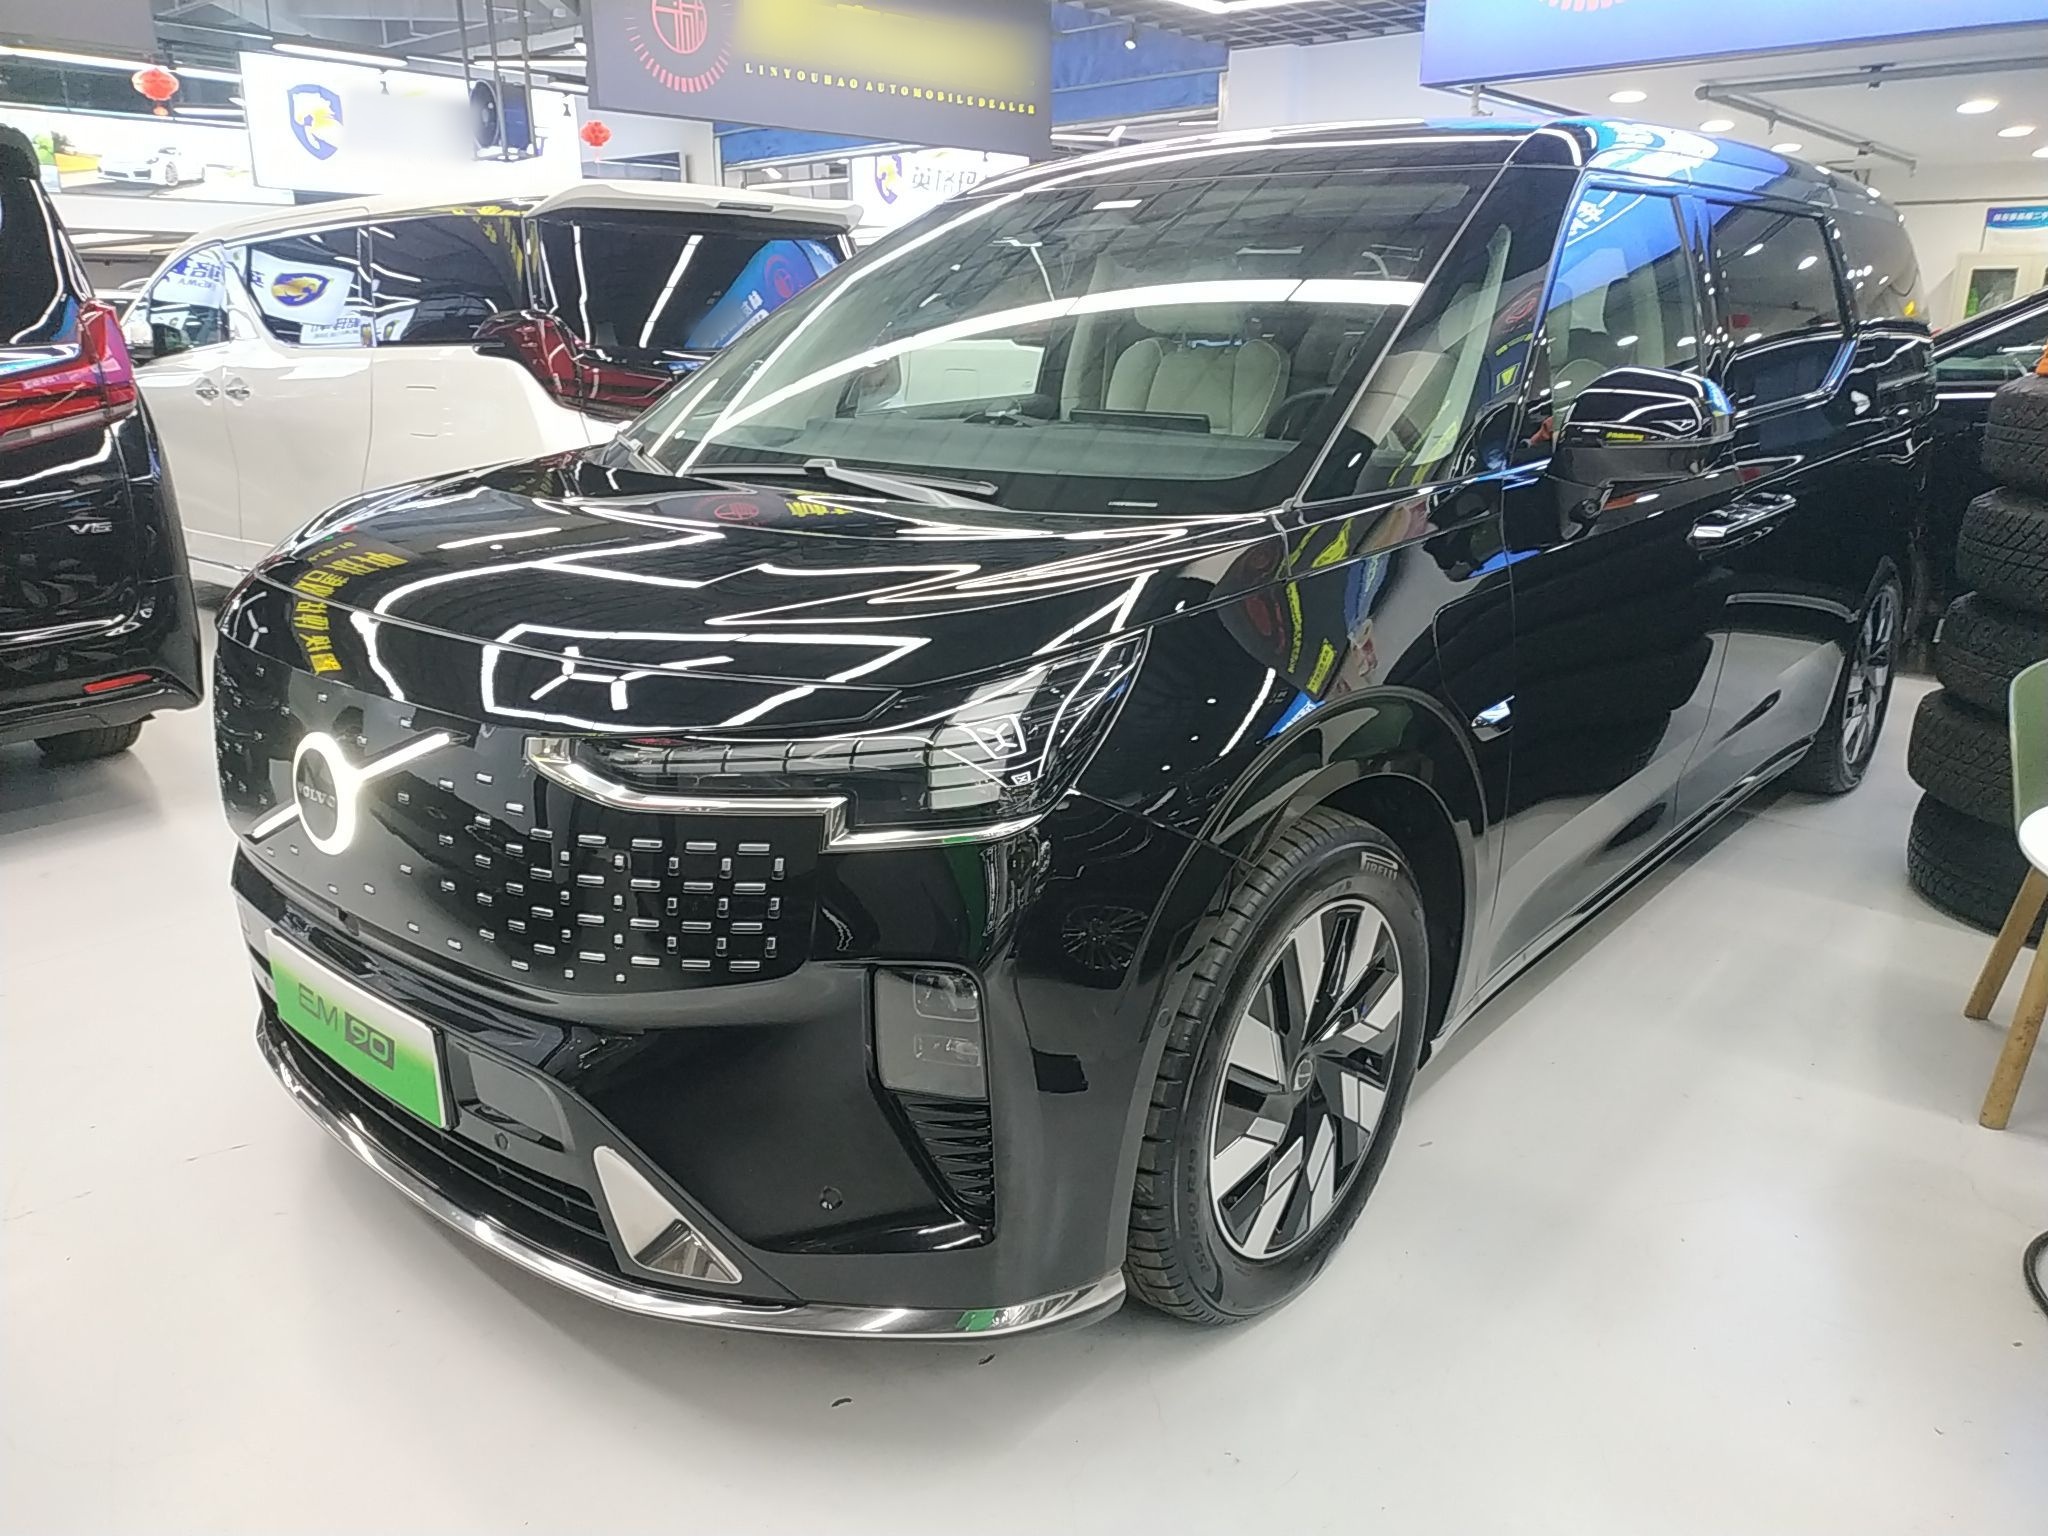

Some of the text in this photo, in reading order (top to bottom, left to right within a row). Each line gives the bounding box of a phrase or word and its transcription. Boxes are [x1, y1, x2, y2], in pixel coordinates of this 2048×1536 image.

[67, 521, 113, 535] V6
[297, 782, 336, 808] VOLVO
[1360, 851, 1399, 881] PIRELLI
[298, 982, 389, 1062] EM 90
